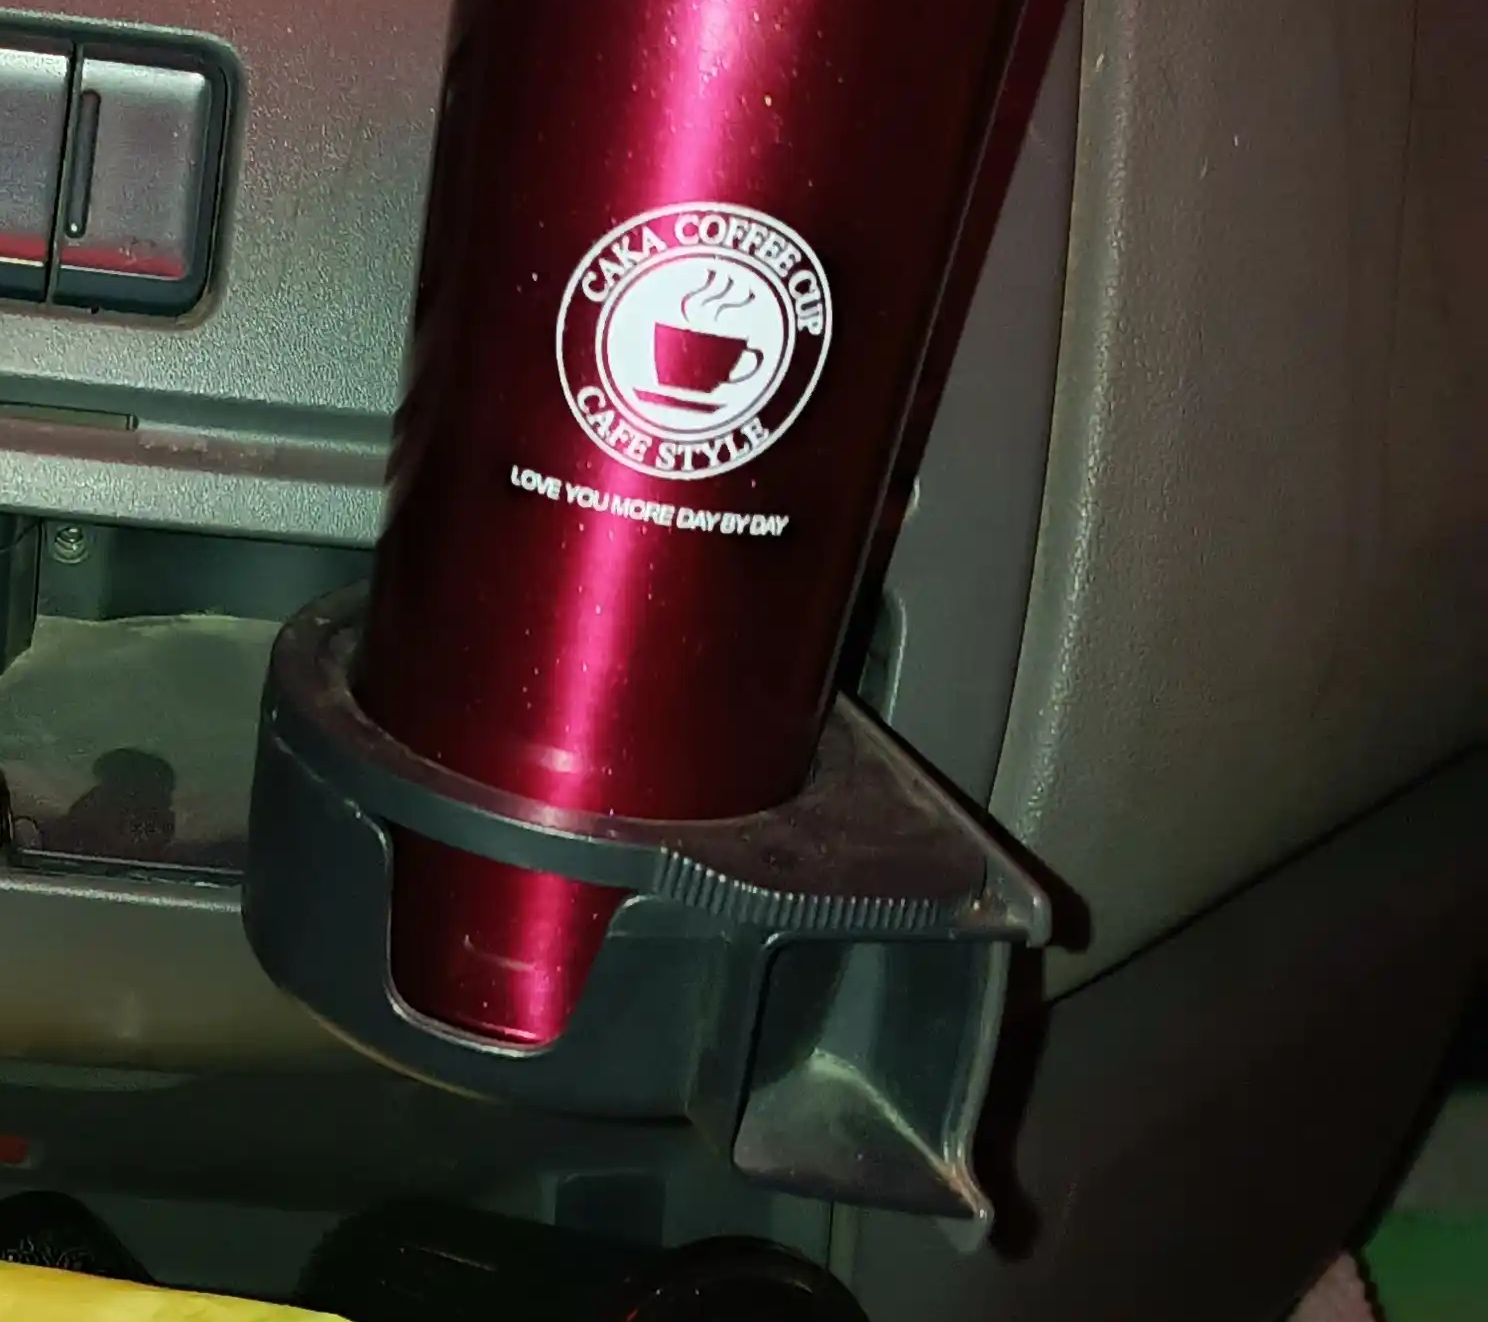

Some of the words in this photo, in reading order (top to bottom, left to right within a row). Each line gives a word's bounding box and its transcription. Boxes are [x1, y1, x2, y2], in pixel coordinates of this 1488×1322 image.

[581, 227, 668, 304] CAKA
[674, 214, 803, 278] COFFEE
[788, 270, 825, 337] CUP
[510, 465, 563, 501] LOVE
[565, 483, 610, 512] YOU
[611, 494, 677, 527] MORE
[676, 508, 720, 532] DAY
[720, 511, 750, 536] BY
[749, 514, 790, 536] DAY
